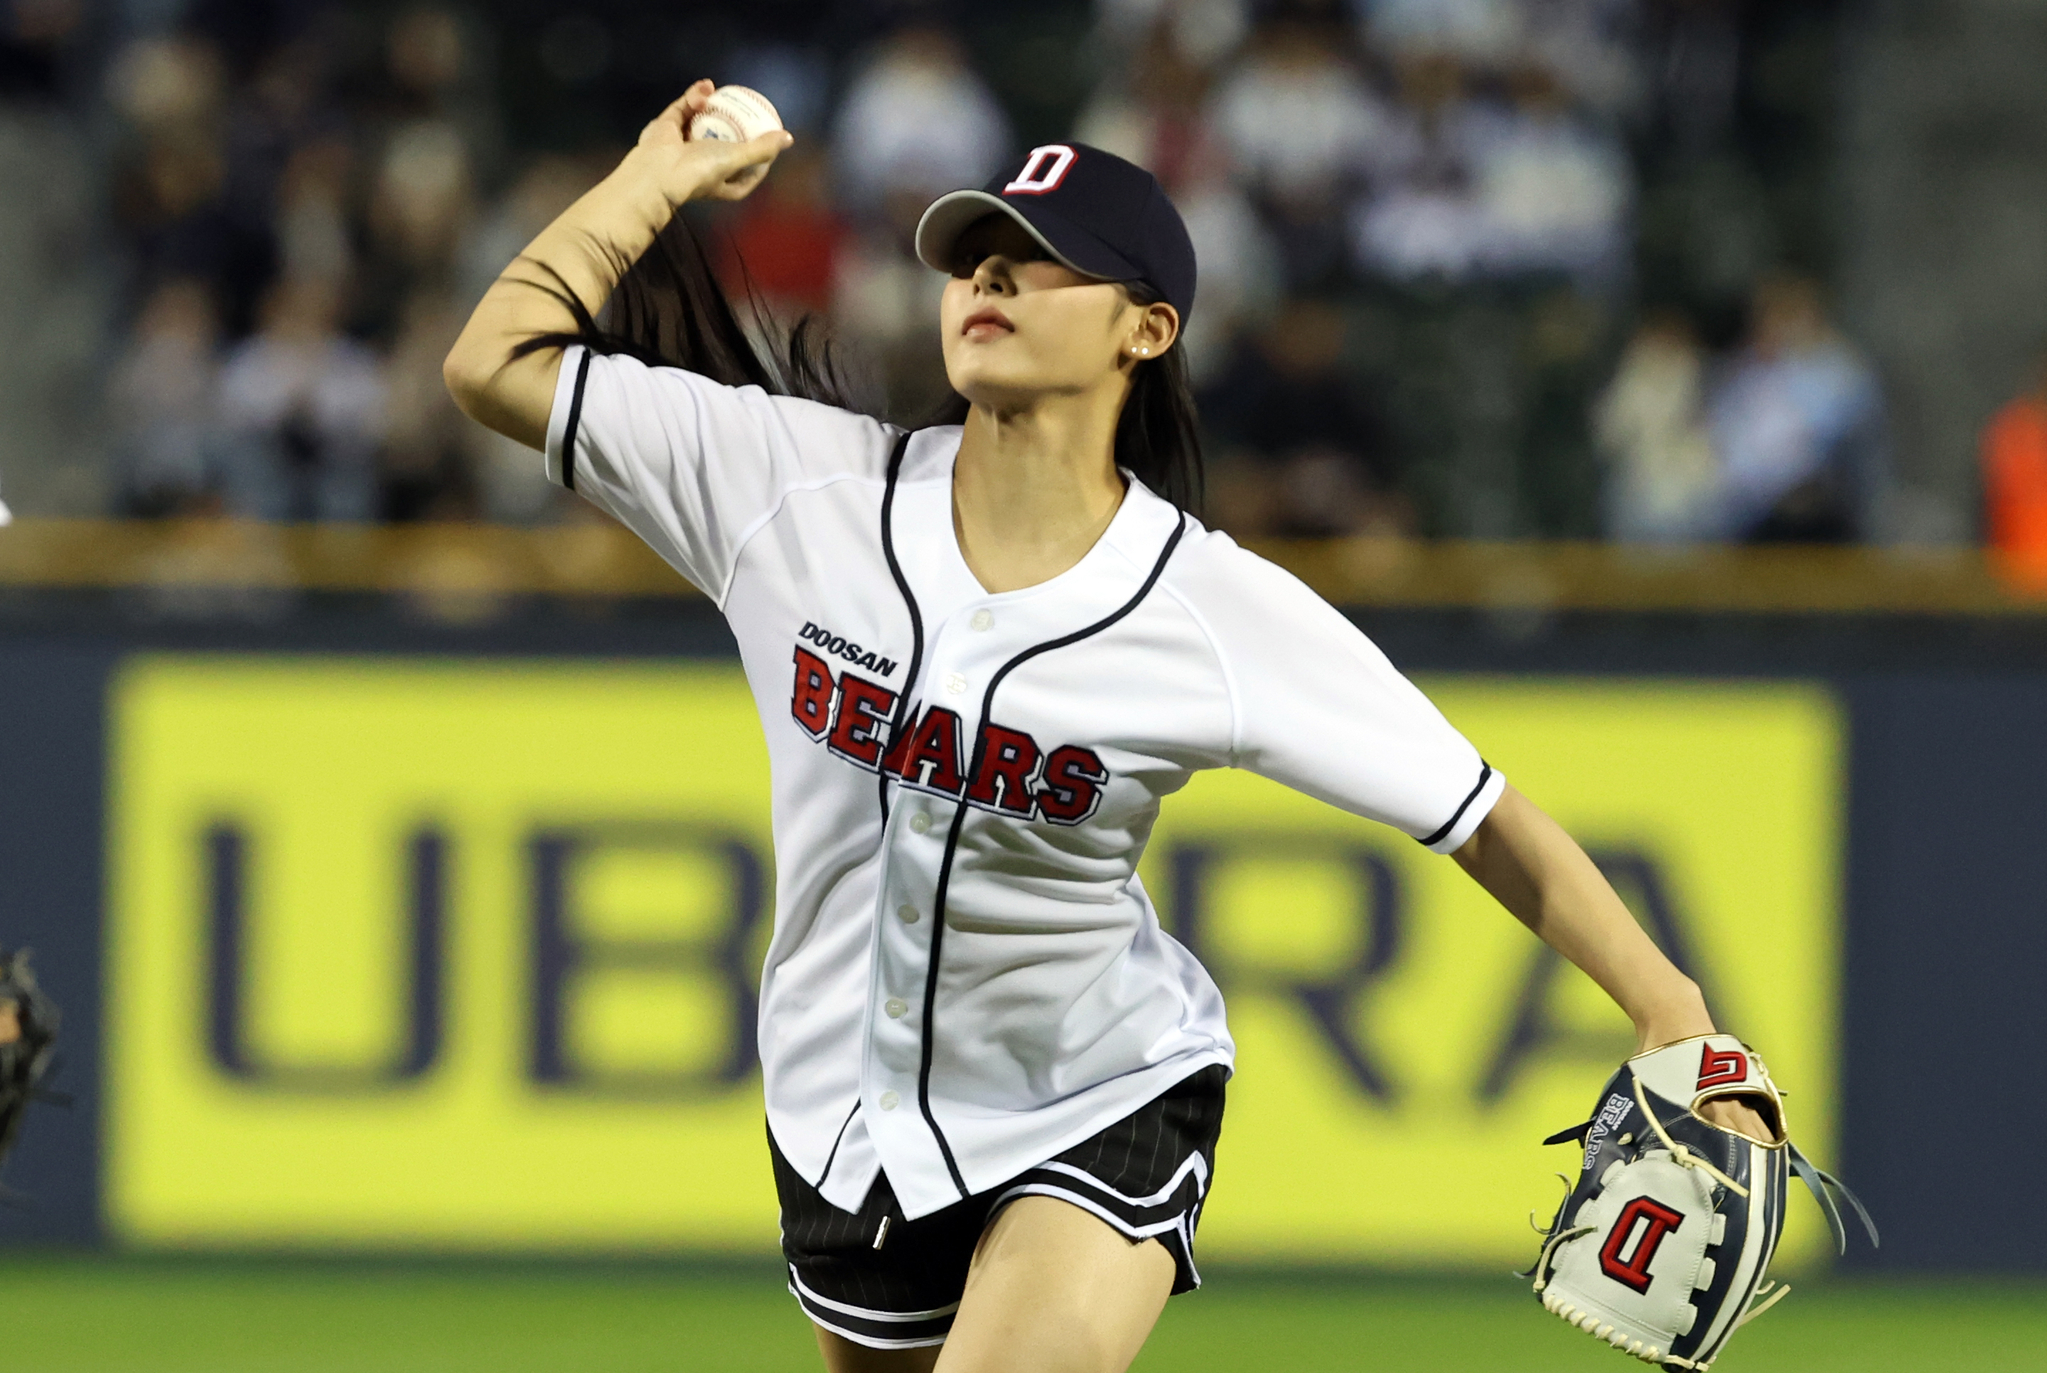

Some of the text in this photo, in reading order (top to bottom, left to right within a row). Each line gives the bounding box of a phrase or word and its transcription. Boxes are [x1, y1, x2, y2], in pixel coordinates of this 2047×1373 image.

[1002, 144, 1078, 195] D
[798, 621, 898, 677] DOOSAN
[791, 644, 1109, 827] BEARS
[198, 812, 1724, 1106] UBRA
[1582, 1093, 1629, 1170] BEARS
[1598, 1195, 1686, 1296] D
